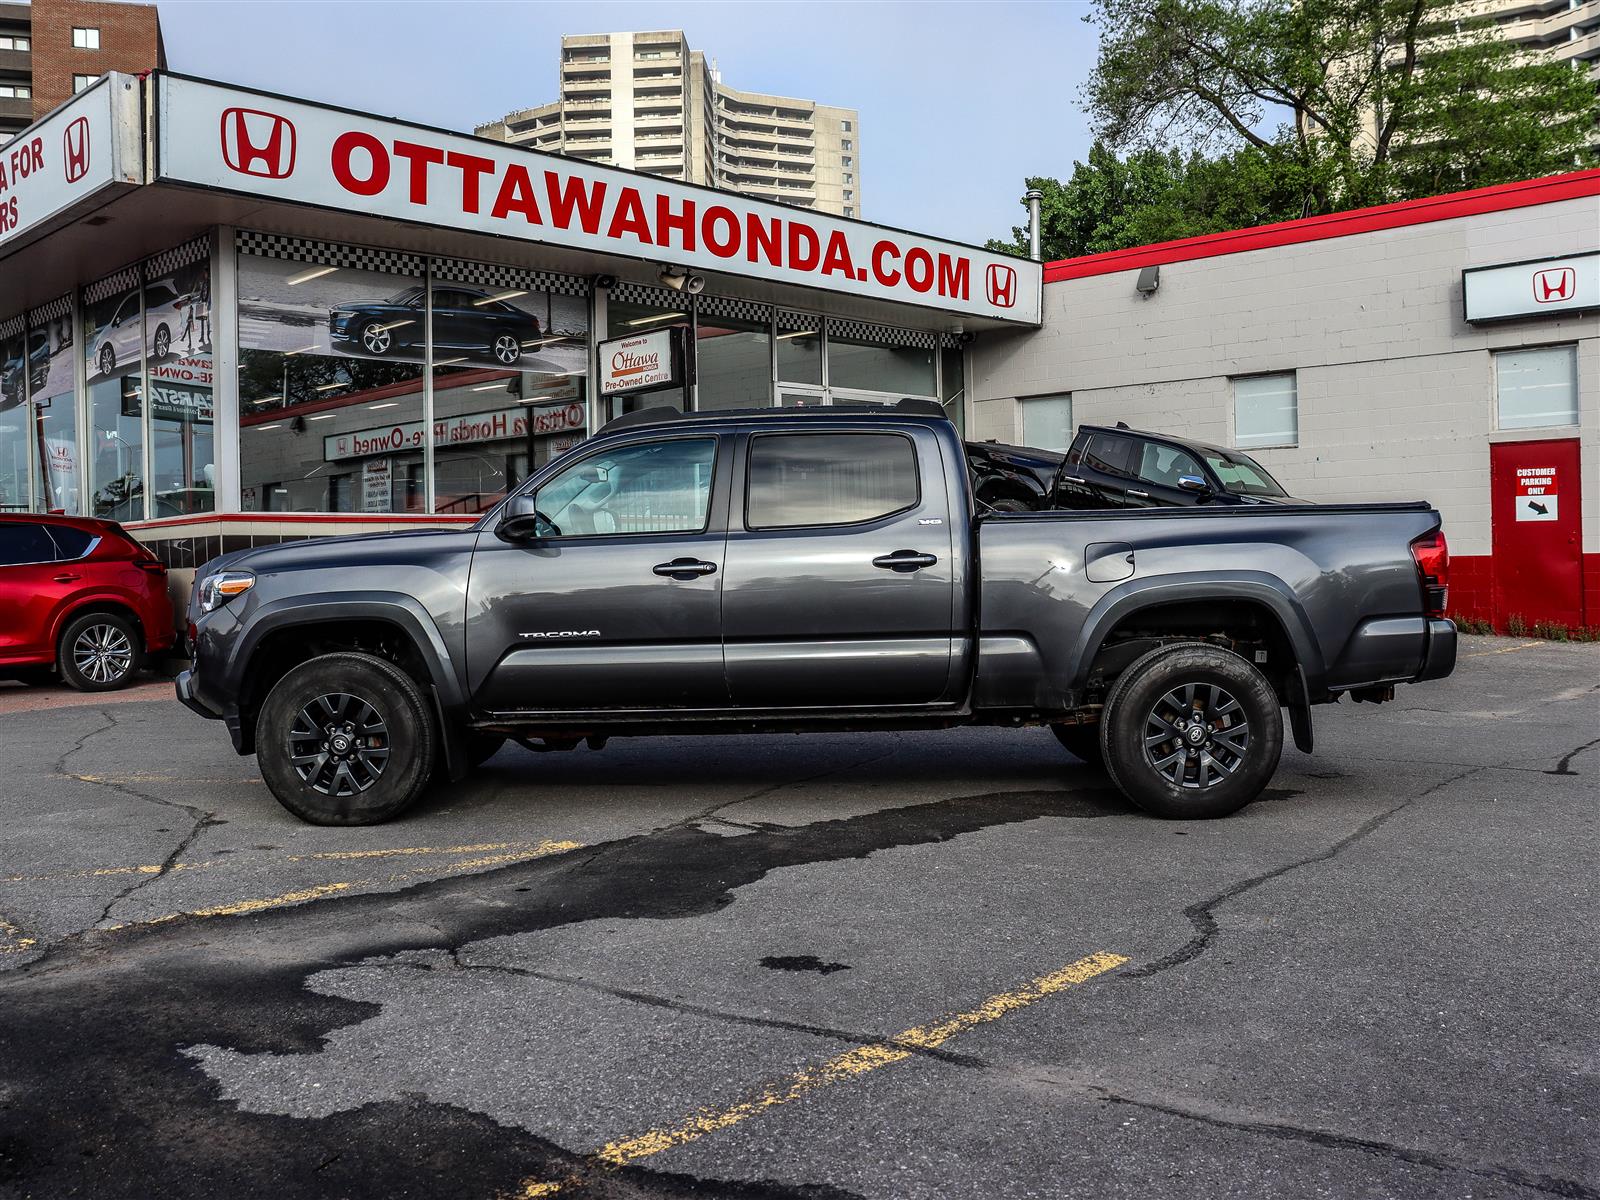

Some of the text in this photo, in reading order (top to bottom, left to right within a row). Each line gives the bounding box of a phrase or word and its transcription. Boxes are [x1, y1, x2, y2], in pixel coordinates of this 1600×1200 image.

[11, 137, 44, 186] FOR
[331, 131, 970, 301] OTTAWAHONDA.COM
[621, 340, 641, 349] Welcome
[612, 351, 658, 370] Ottawa
[606, 372, 668, 390] Pre-Owned Centre
[1517, 467, 1556, 476] CUSTOMER
[1521, 478, 1552, 486] PARKING
[1527, 487, 1545, 495] ONLY
[518, 630, 601, 638] TACOMA
